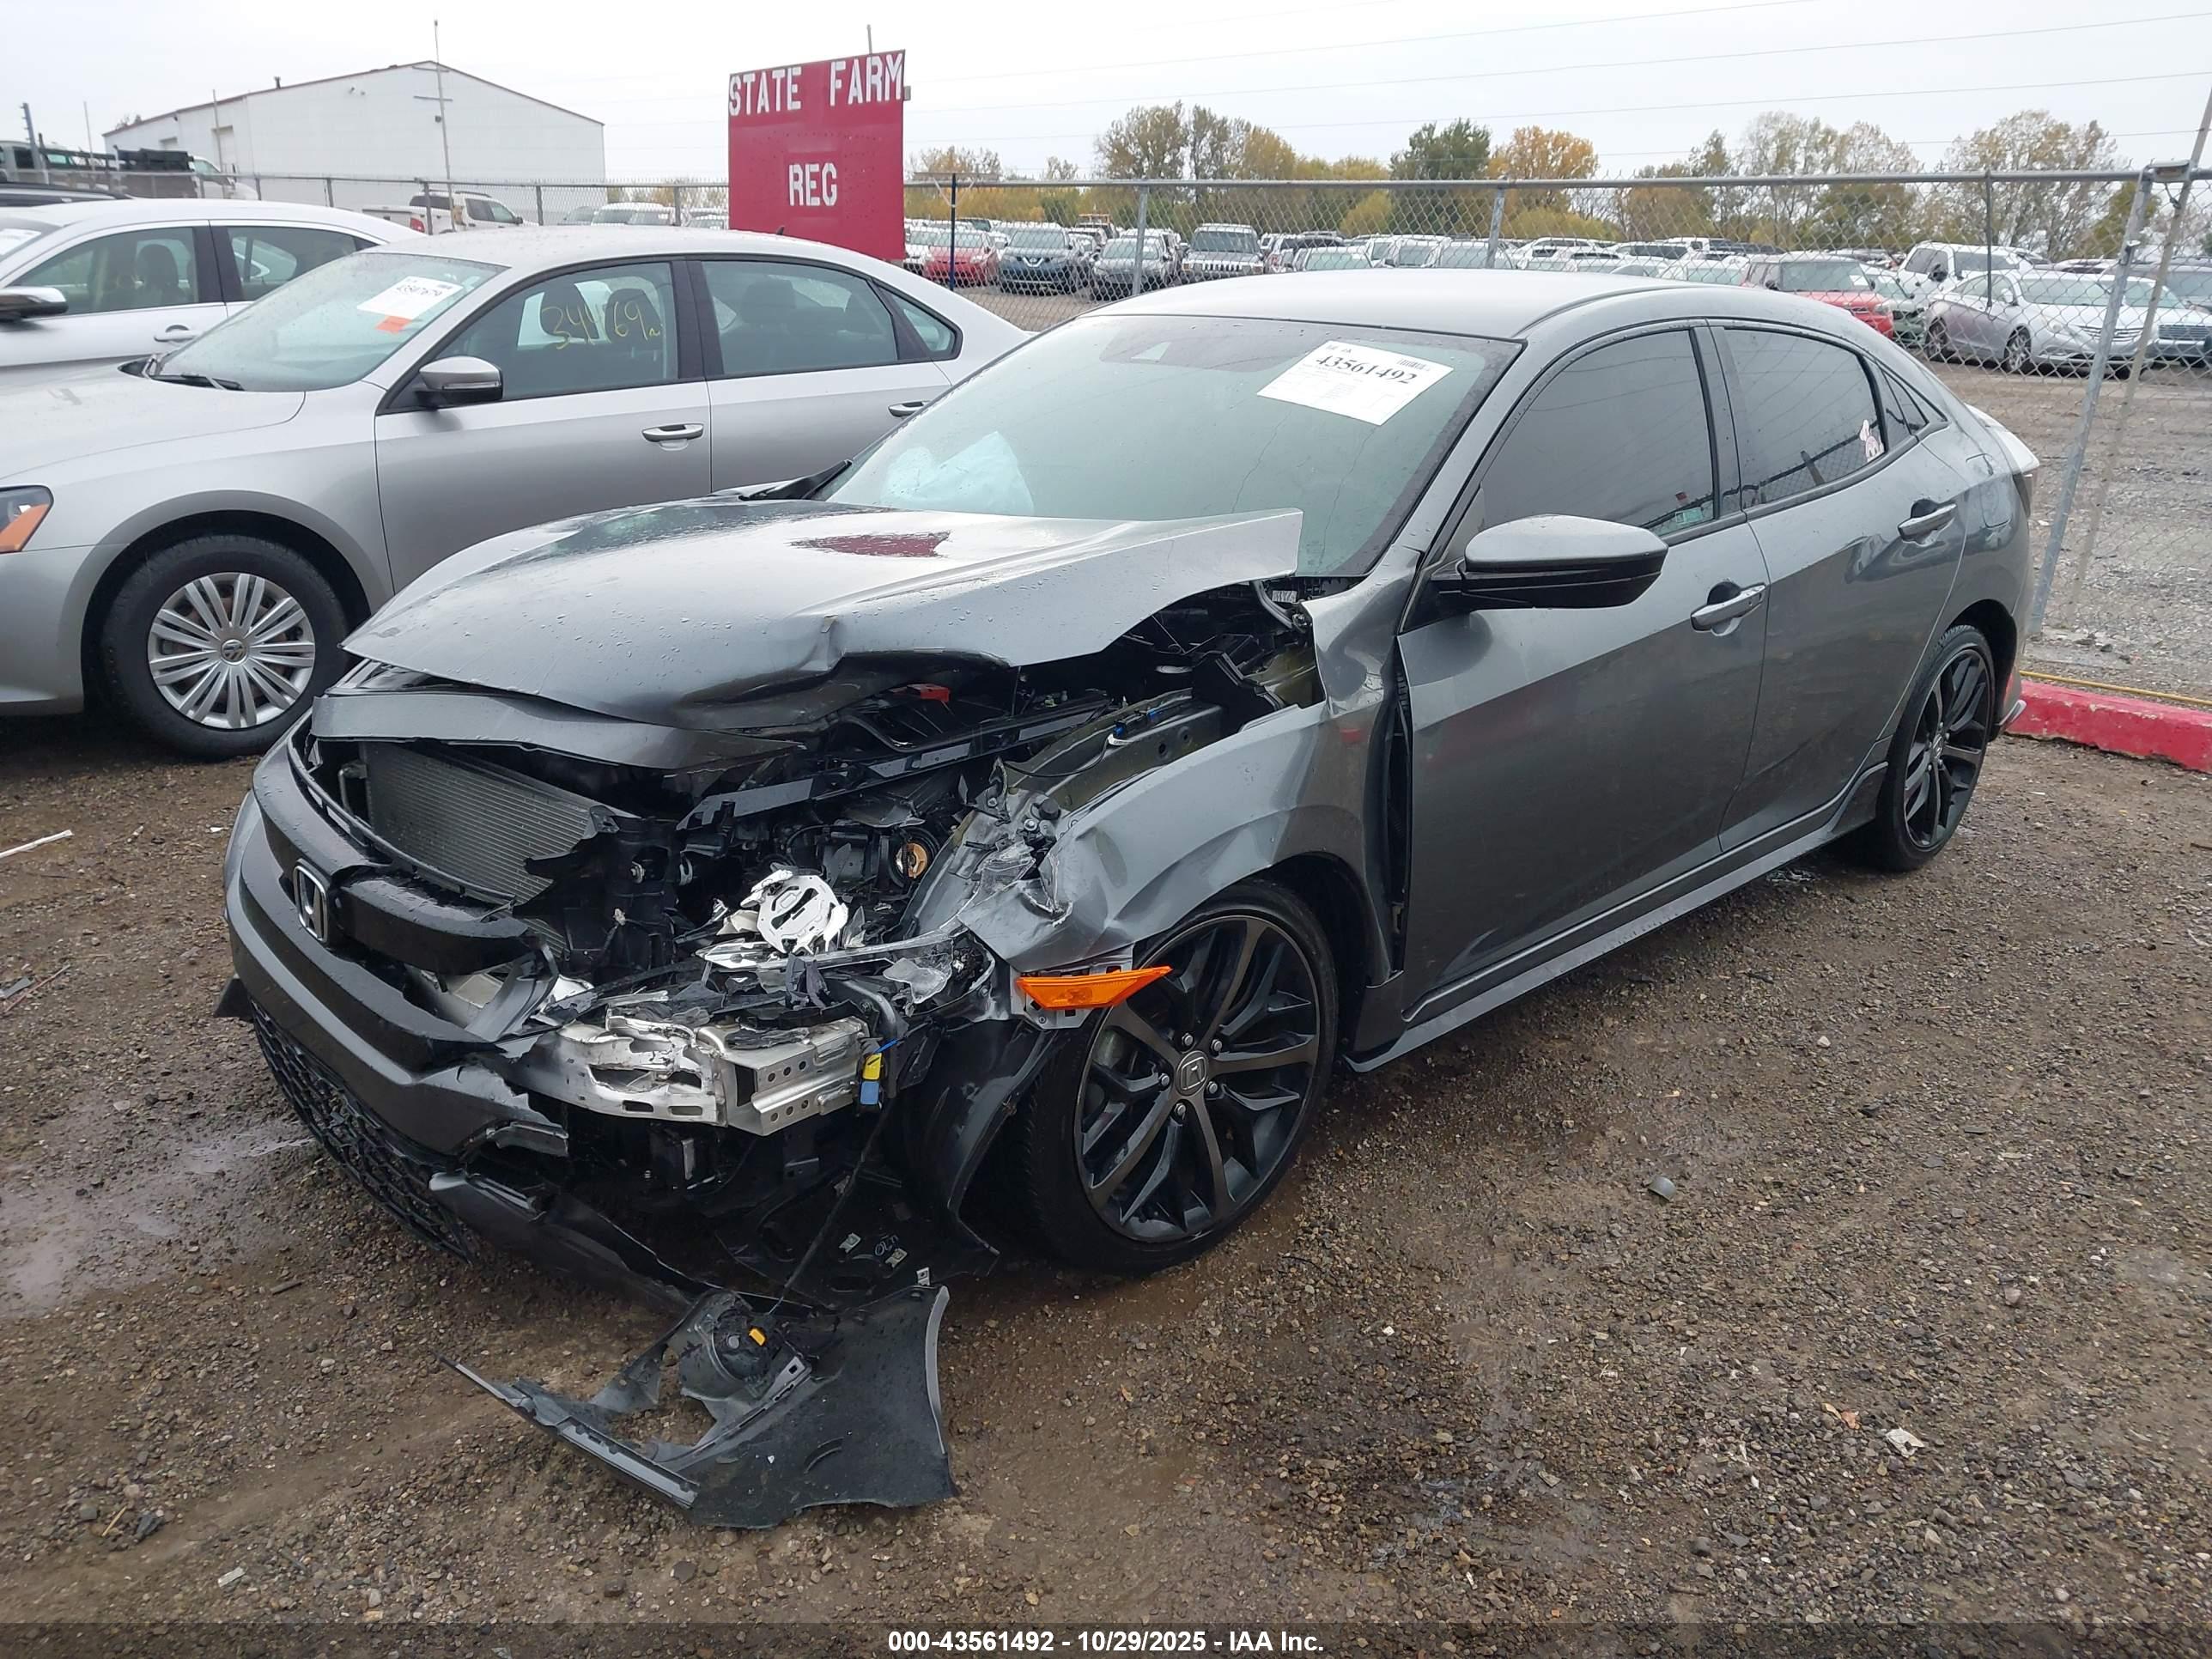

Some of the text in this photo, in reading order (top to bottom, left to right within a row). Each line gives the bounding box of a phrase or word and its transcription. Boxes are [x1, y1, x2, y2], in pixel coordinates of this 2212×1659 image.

[729, 52, 903, 116] STATE FARM
[788, 162, 838, 207] REG
[1316, 355, 1418, 385] 43561492
